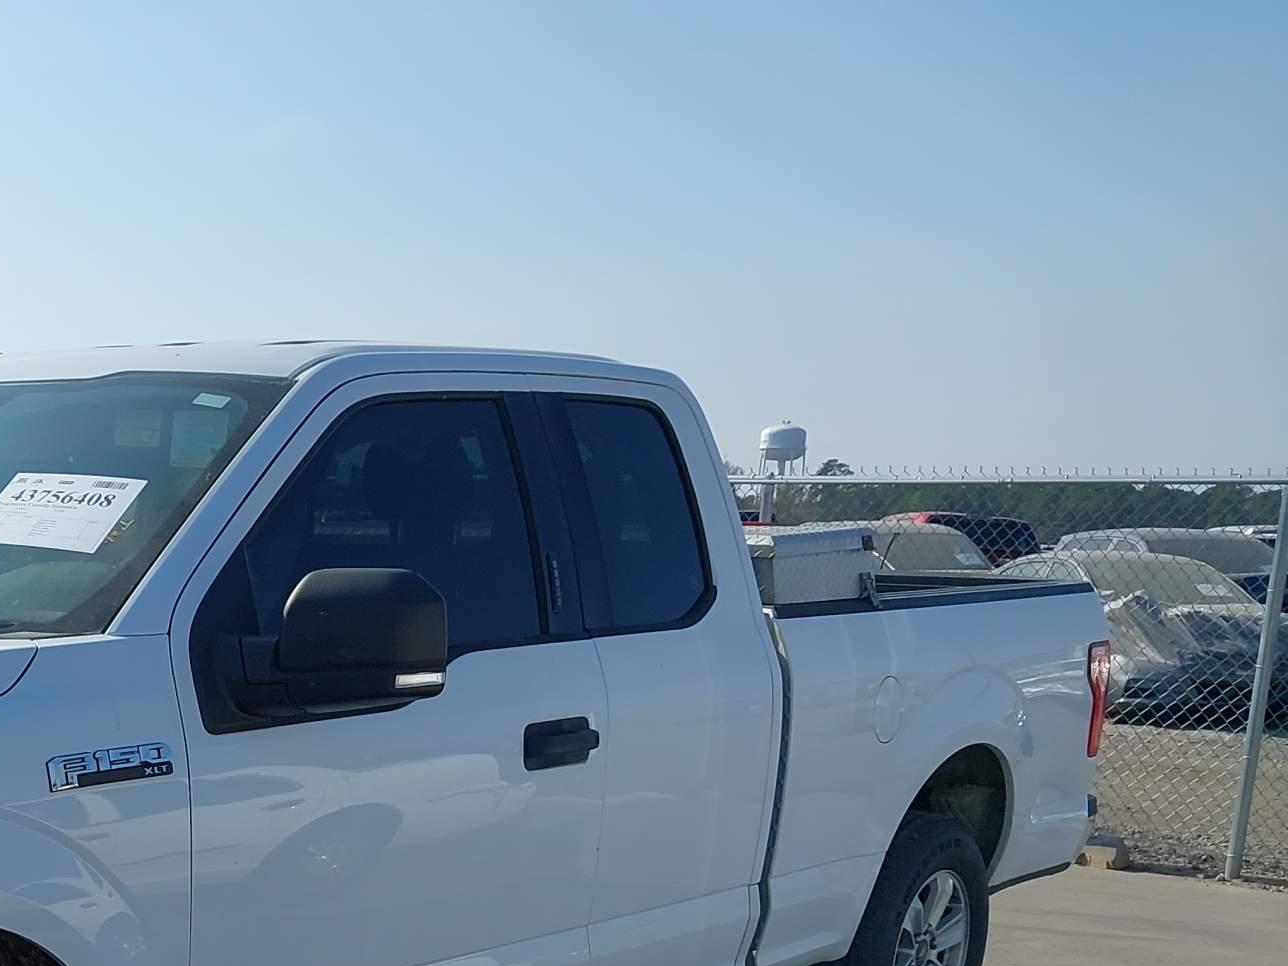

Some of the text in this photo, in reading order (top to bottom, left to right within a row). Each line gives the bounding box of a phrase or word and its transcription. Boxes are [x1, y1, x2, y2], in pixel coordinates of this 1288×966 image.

[10, 488, 117, 508] 43756408
[46, 742, 170, 792] F150
[143, 764, 169, 776] XLT
